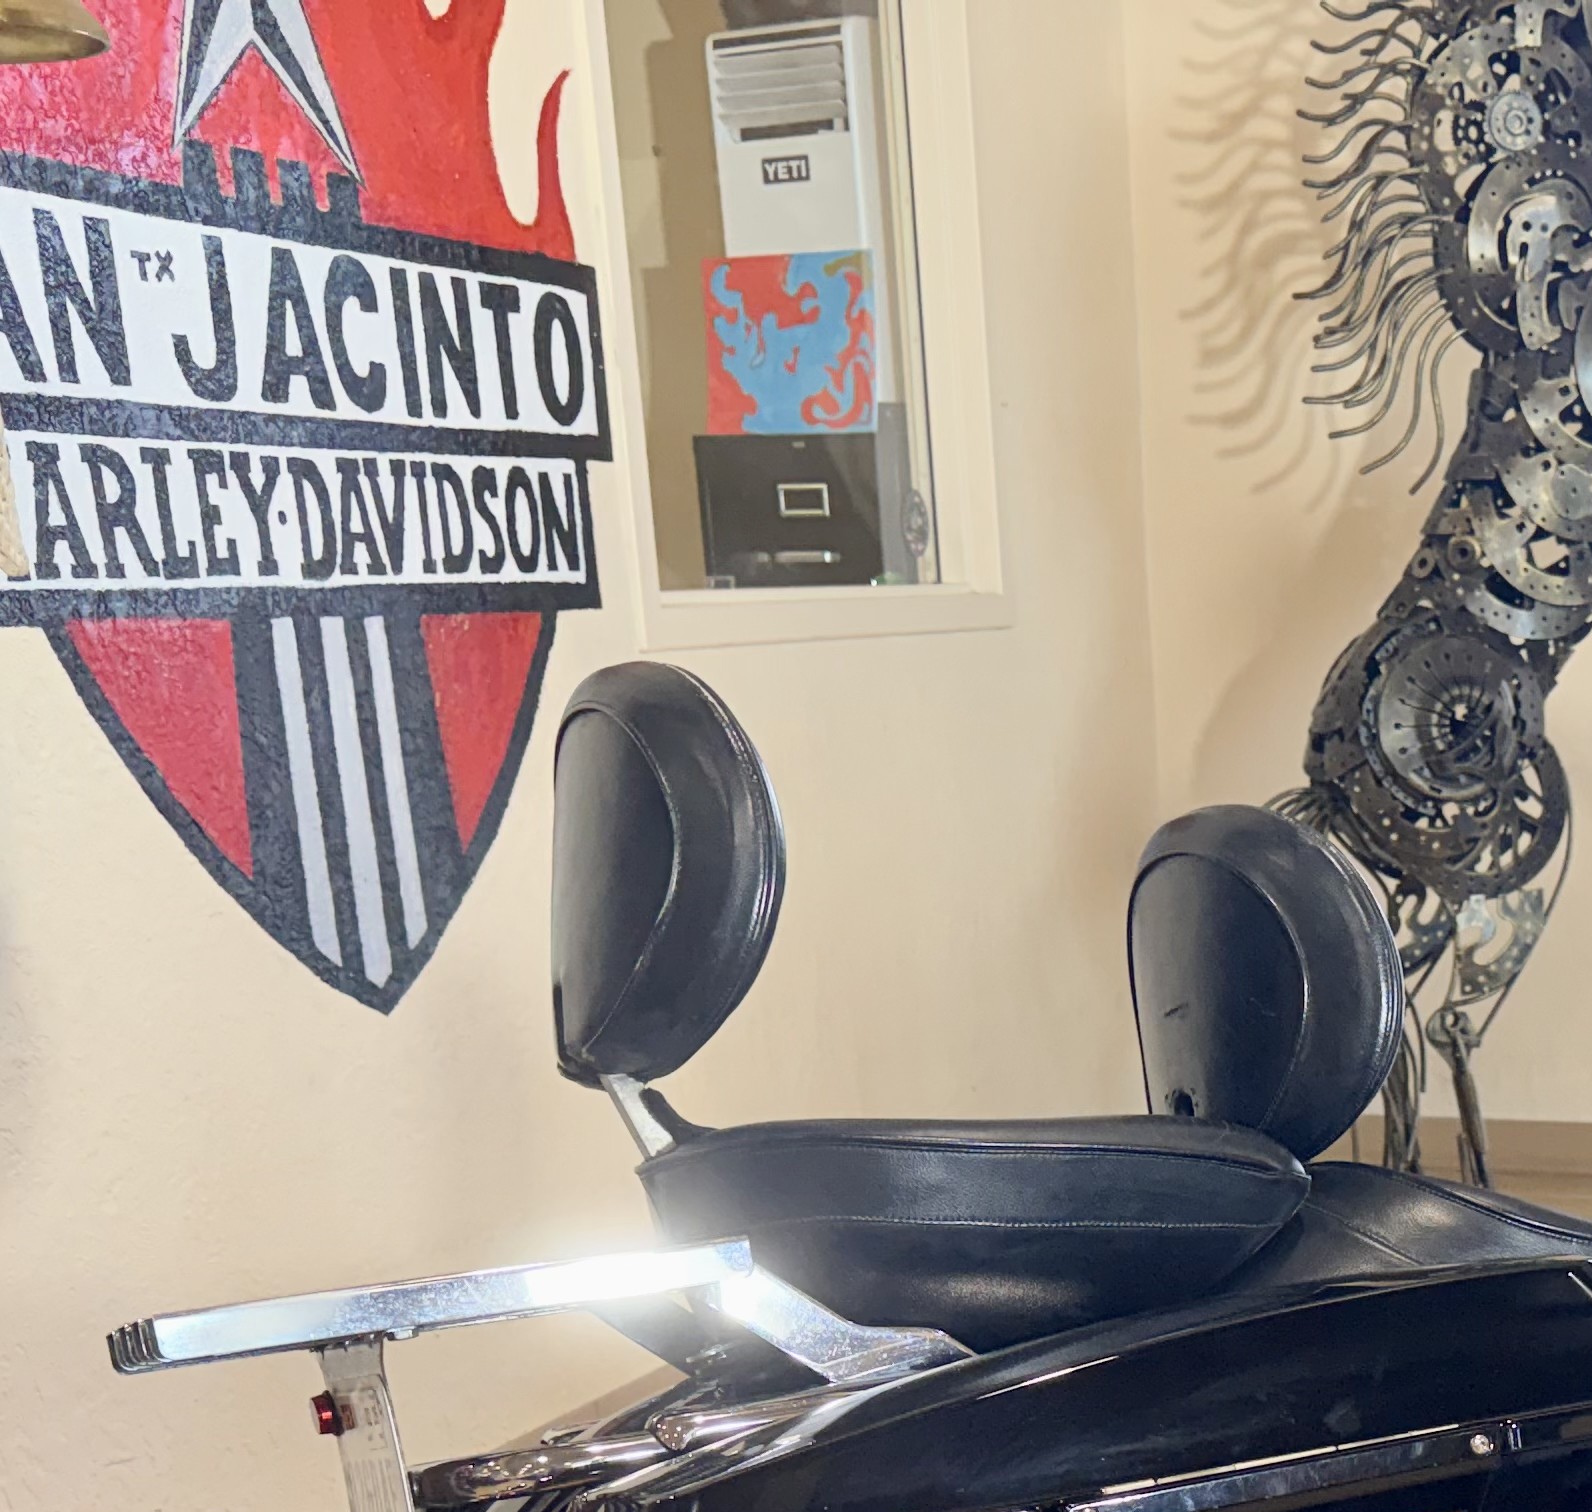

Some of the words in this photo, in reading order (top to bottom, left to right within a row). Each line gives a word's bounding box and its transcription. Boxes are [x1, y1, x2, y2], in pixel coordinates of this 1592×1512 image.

[763, 159, 807, 181] YETI
[130, 248, 175, 283] TX
[172, 234, 585, 427] JACINTO
